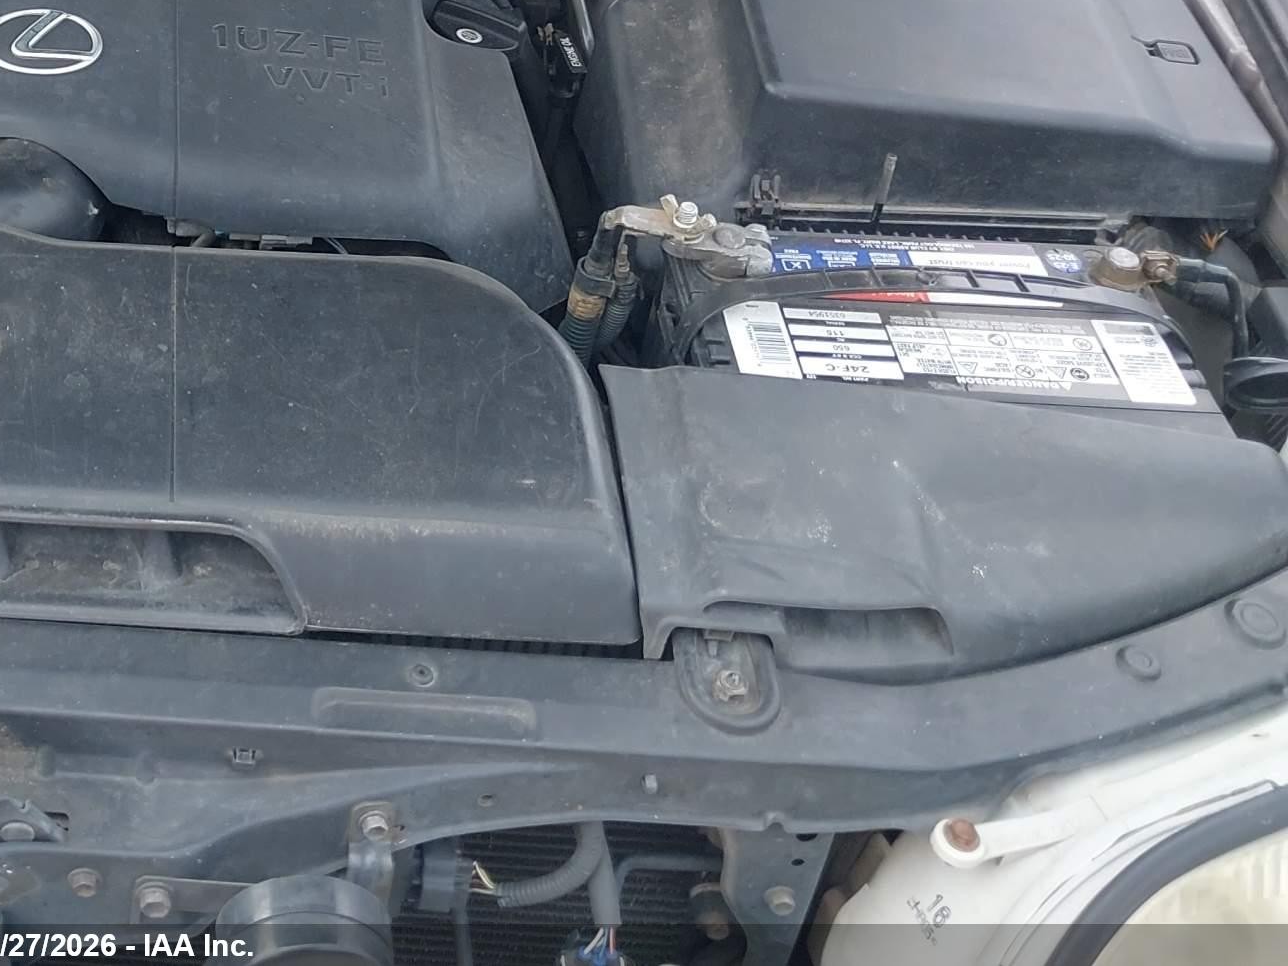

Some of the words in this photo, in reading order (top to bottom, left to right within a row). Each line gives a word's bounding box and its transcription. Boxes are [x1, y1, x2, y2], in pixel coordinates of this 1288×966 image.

[212, 23, 387, 65] 1UZ-FE
[264, 64, 388, 98] VVT-i
[825, 363, 871, 373] 24F-C
